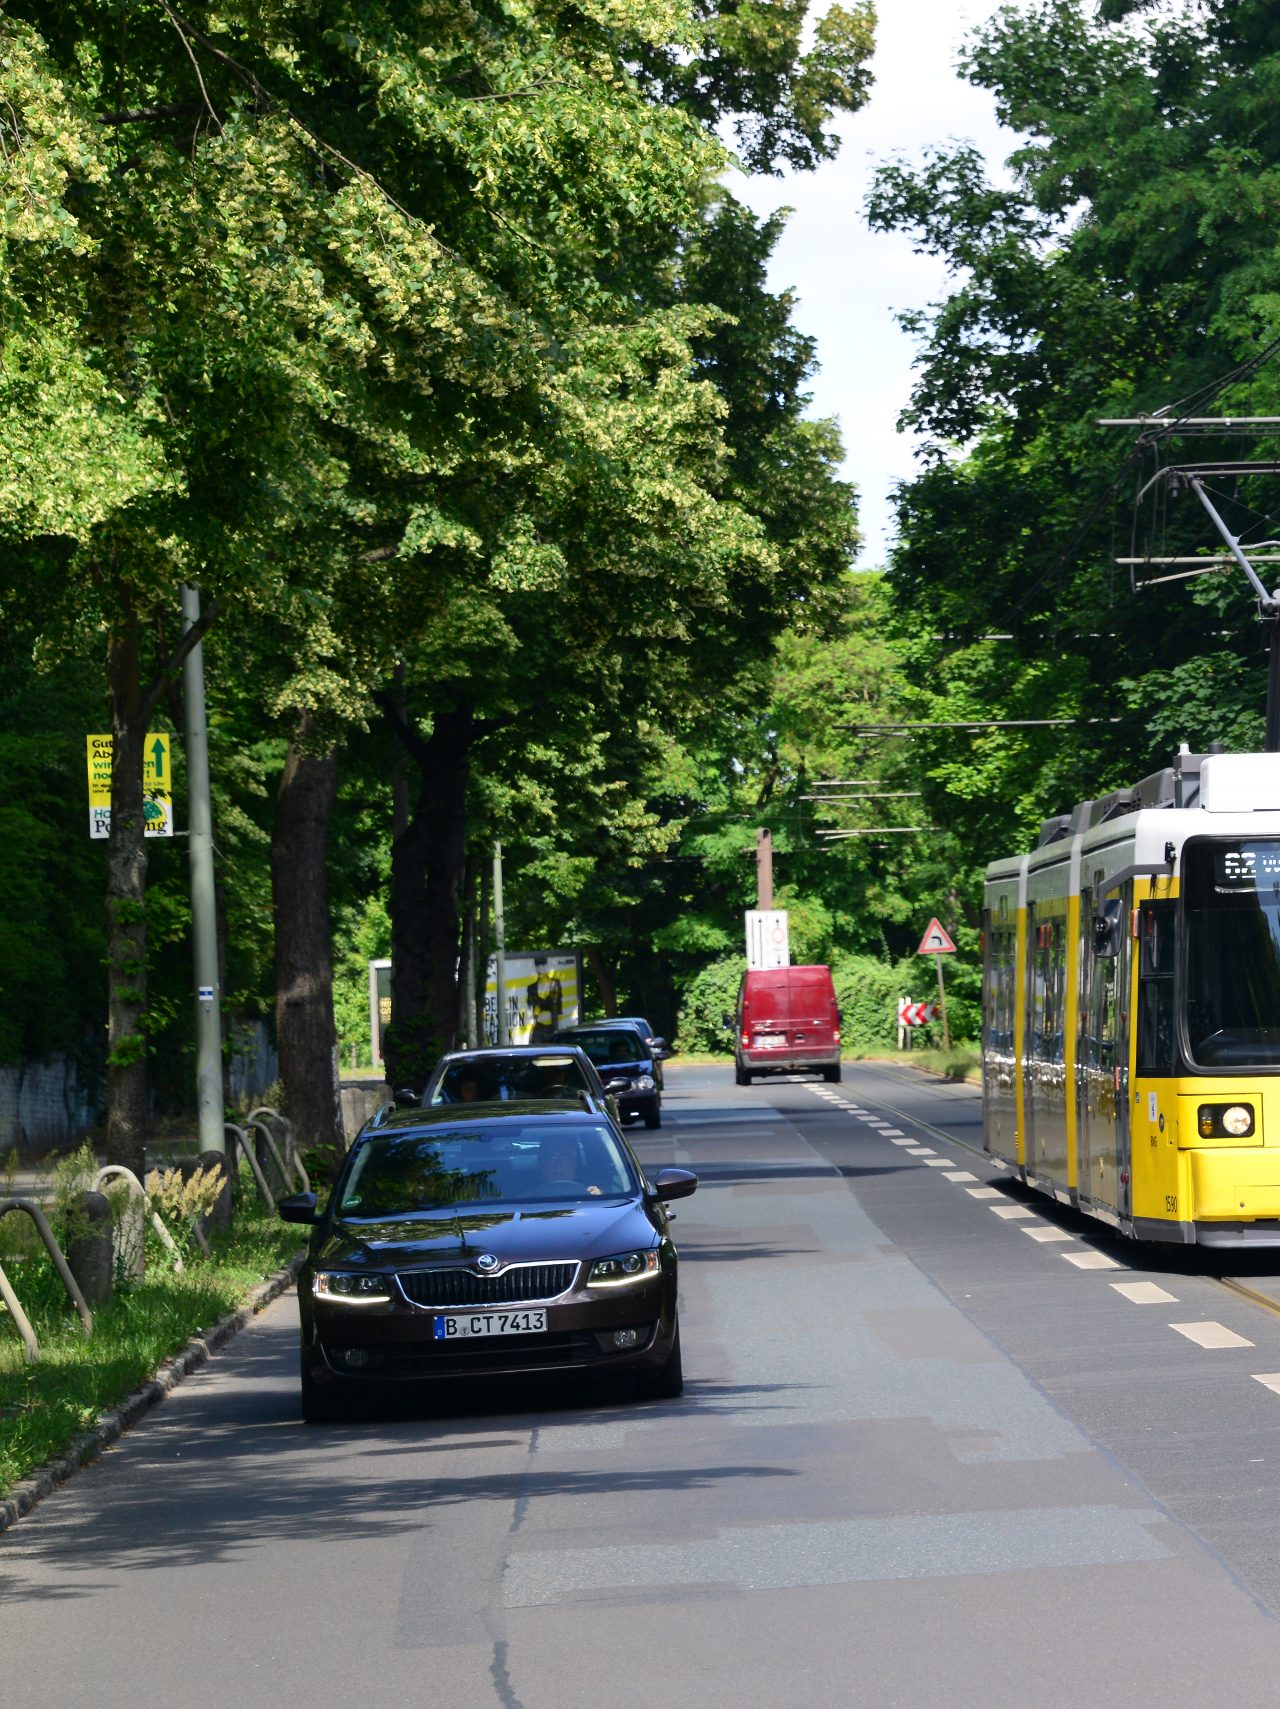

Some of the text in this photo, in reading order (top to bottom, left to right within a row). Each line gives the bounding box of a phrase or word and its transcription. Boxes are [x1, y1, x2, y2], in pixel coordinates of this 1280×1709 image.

[1225, 852, 1256, 878] 62
[1165, 1195, 1178, 1213] 1590
[446, 1318, 458, 1336] B
[470, 1315, 494, 1334] CT
[498, 1312, 544, 1332] 7413
